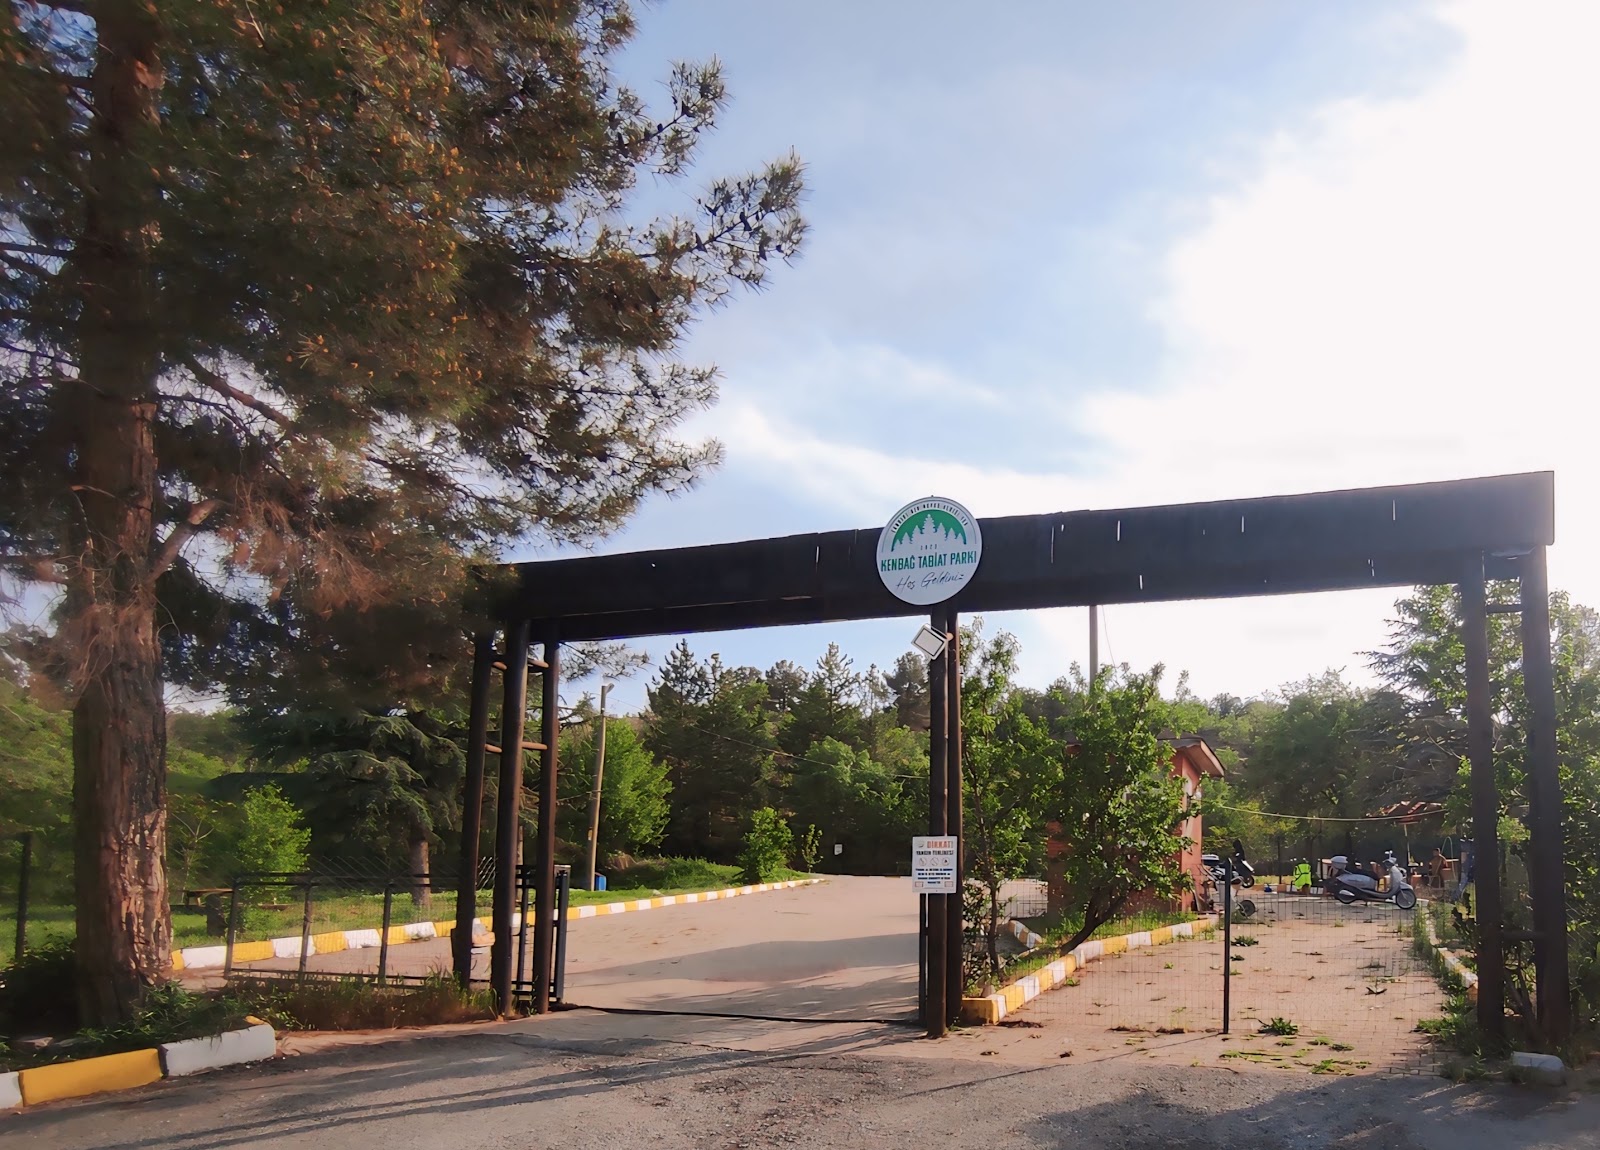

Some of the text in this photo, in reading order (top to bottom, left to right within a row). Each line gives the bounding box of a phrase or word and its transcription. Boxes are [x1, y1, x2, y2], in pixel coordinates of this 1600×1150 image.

[881, 551, 977, 572] KENBAĞ TABİAT PARKI
